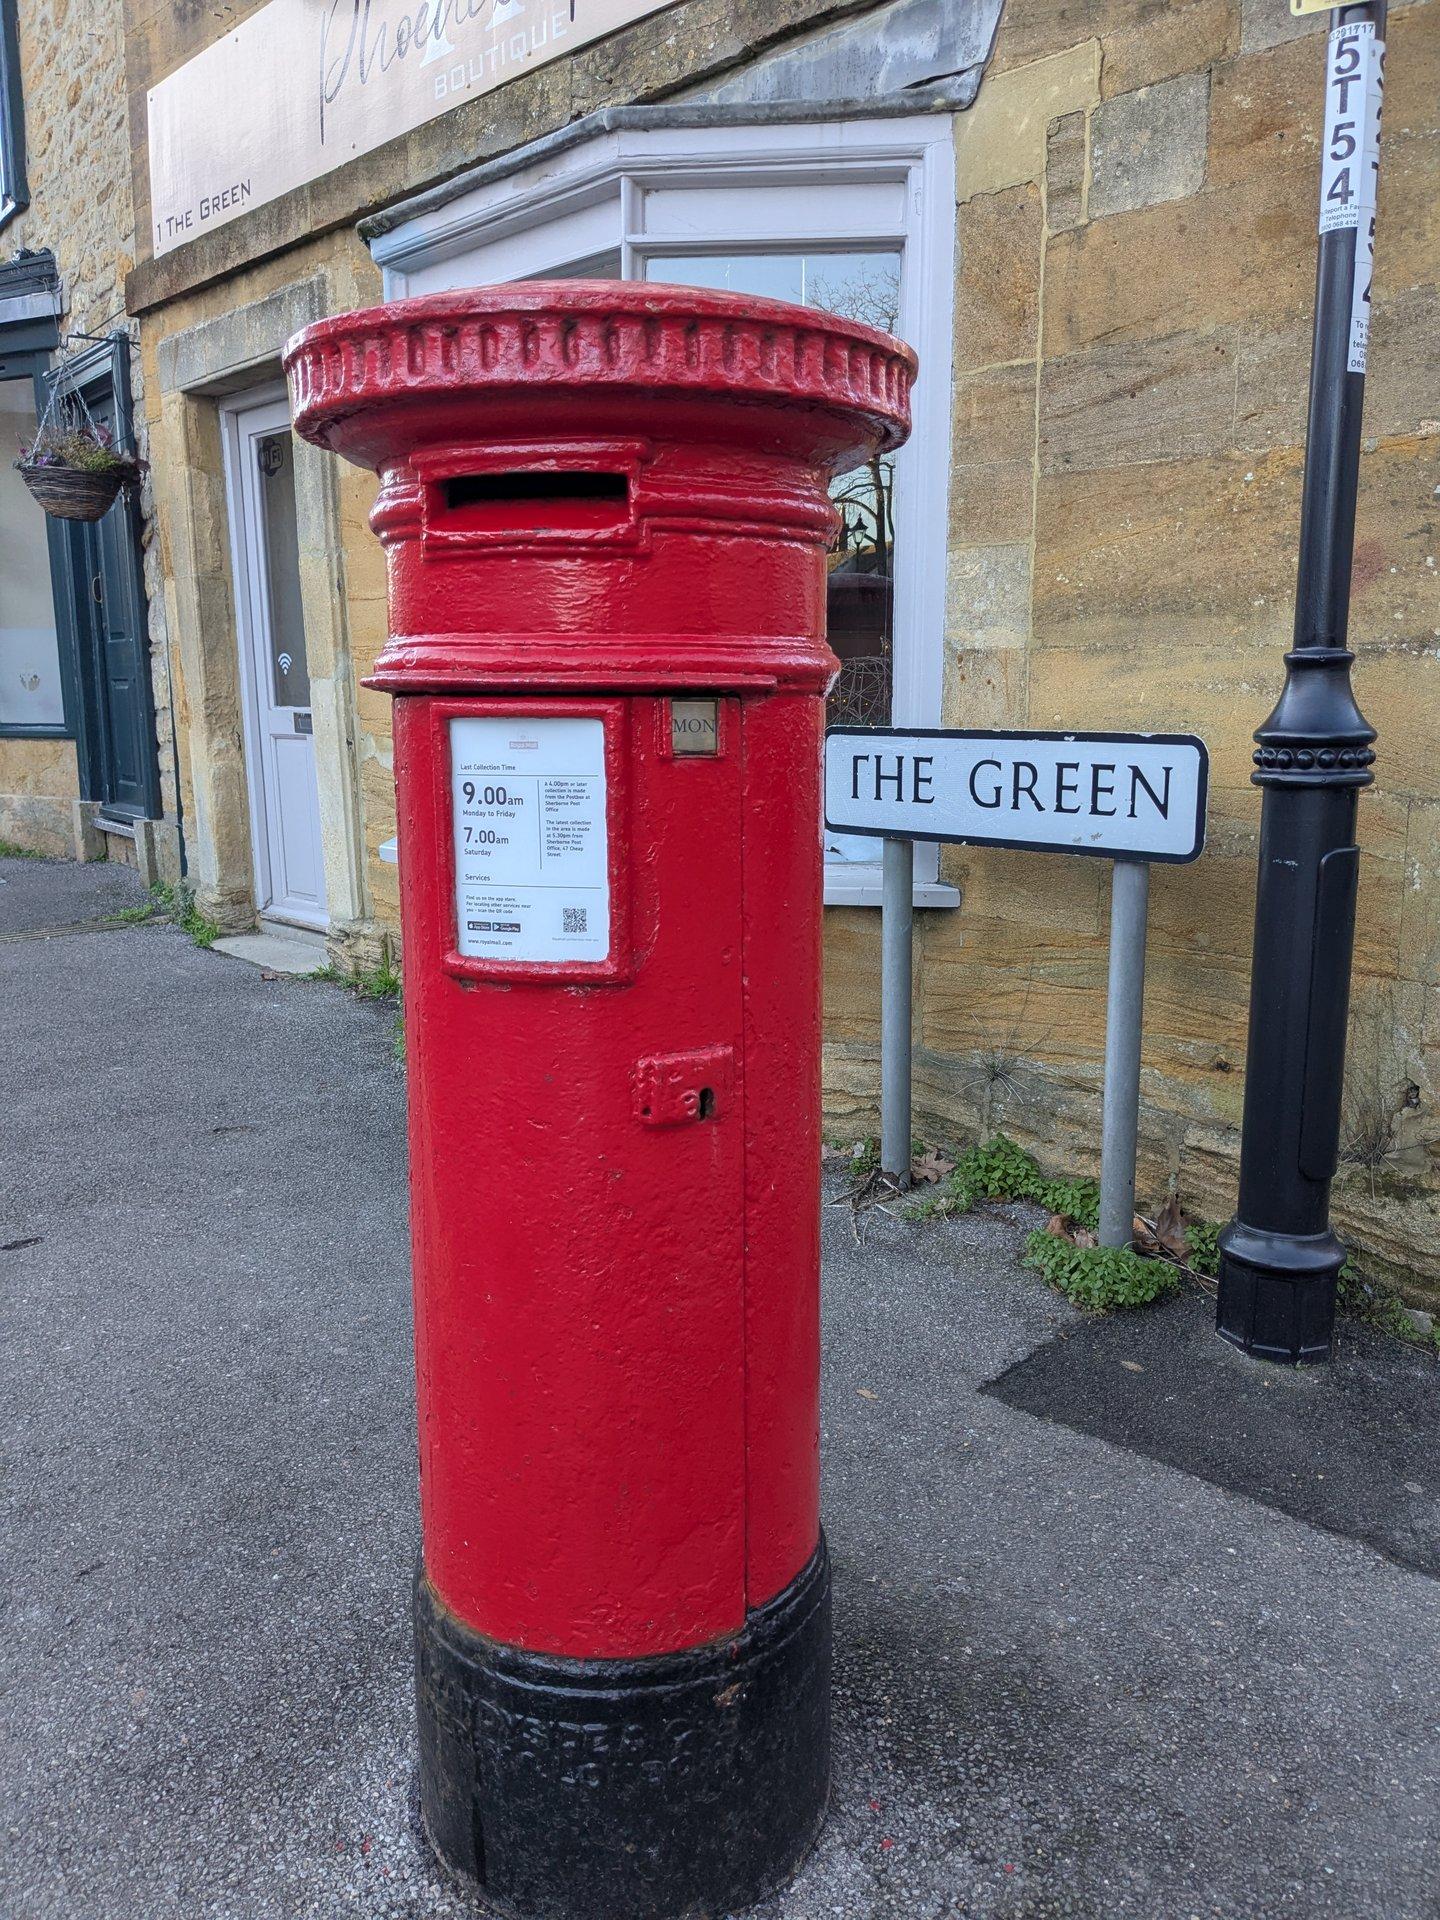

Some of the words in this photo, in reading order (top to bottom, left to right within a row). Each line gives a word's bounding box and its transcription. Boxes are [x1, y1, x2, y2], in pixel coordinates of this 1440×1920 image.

[434, 10, 568, 100] BOUTIQUE
[157, 223, 162, 242] 1
[166, 210, 193, 236] THE
[200, 179, 251, 220] GREEN
[1356, 320, 1364, 329] To
[672, 718, 714, 733] MON
[462, 782, 524, 806] 9.00am
[851, 755, 935, 804] THE
[969, 759, 1173, 820] GREEN
[464, 827, 509, 844] 7.00am
